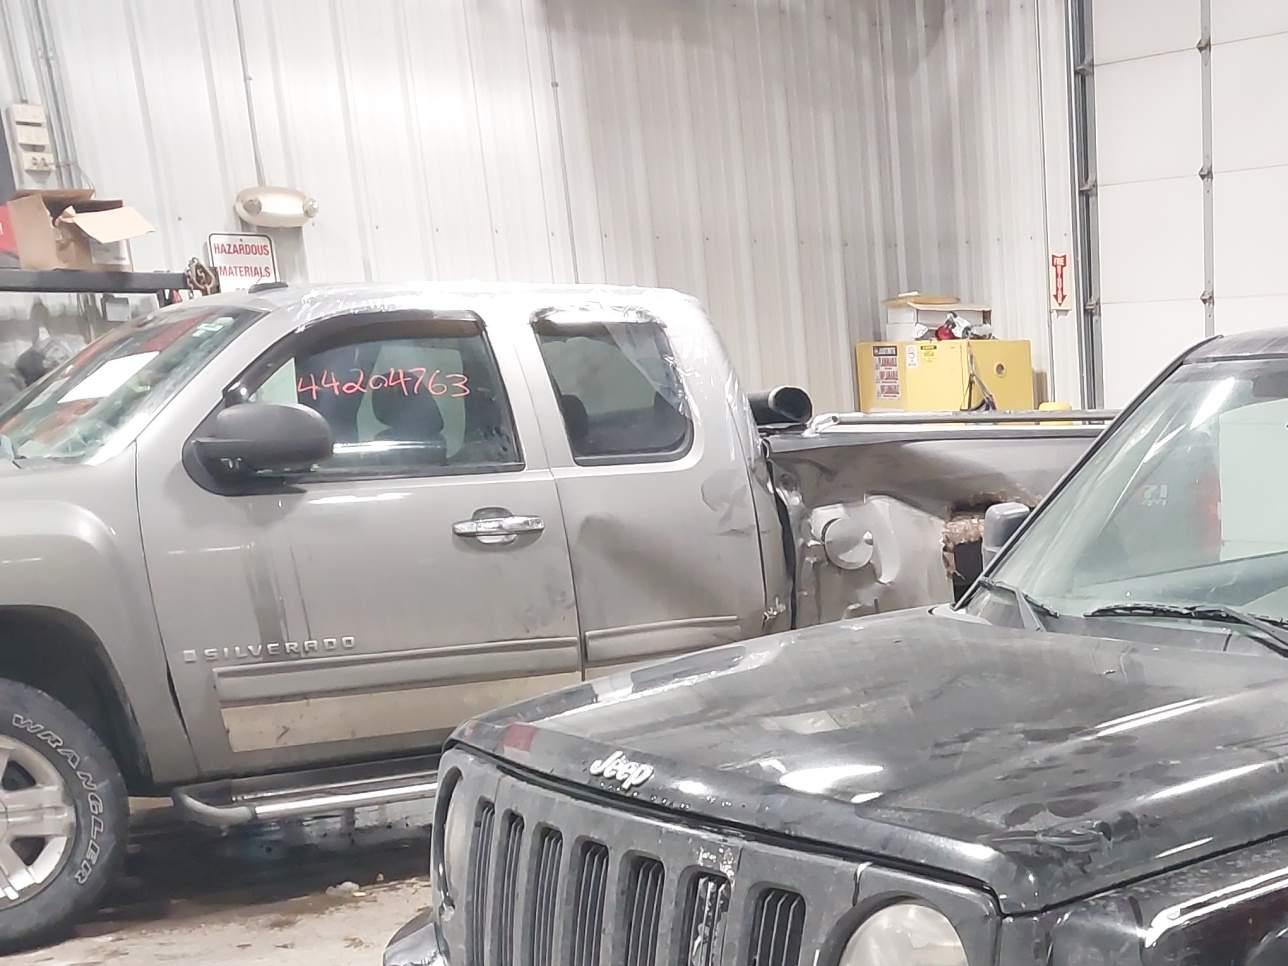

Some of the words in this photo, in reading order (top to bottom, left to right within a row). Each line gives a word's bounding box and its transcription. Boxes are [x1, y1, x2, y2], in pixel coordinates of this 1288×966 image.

[213, 243, 270, 256] HAZARDOUS
[218, 265, 271, 278] MATERIALS
[297, 367, 471, 400] 44204763
[203, 636, 356, 661] SILVERADO
[589, 750, 655, 790] Jeep
[11, 713, 104, 885] WRANGLER
